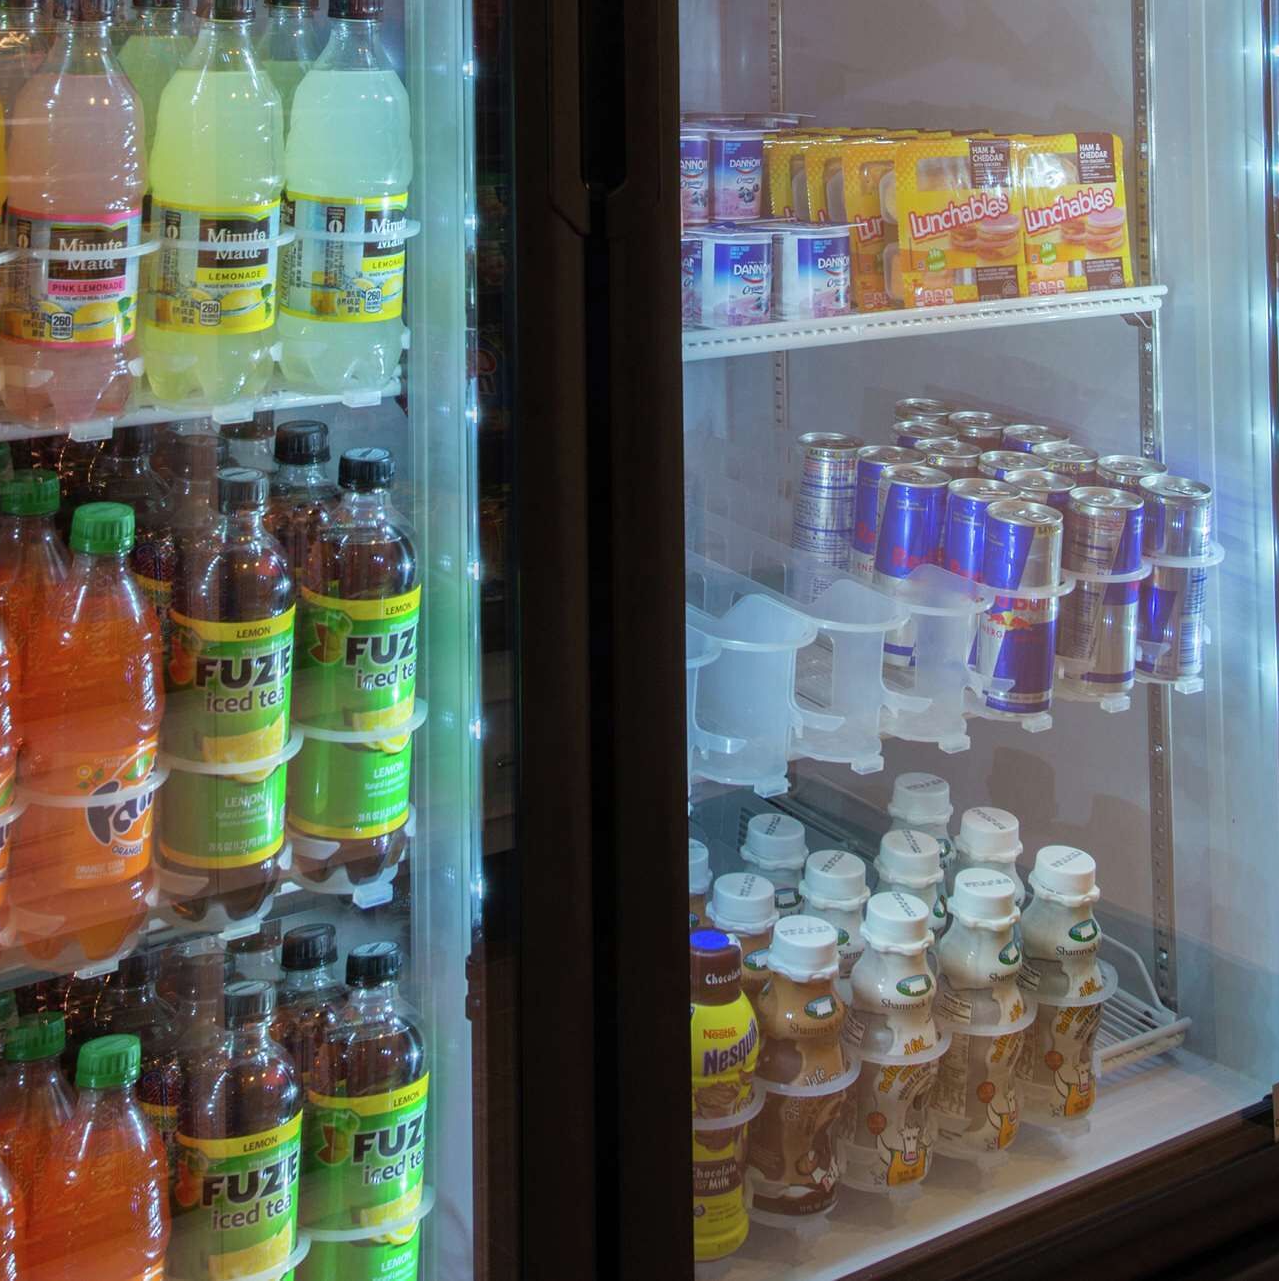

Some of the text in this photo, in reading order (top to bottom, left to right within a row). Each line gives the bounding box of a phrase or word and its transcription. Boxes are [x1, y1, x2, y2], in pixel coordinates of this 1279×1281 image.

[972, 146, 989, 155] HAM
[1079, 143, 1095, 152] HAM
[1079, 150, 1108, 160] CHEDDAR
[729, 158, 761, 169] DANNON
[972, 153, 1004, 163] CHEDDAR
[910, 193, 1009, 239] Lunchables
[1024, 187, 1114, 236] Lunchables
[370, 217, 407, 235] Minut
[208, 228, 266, 244] Minute
[59, 238, 123, 251] Minute
[67, 259, 115, 271] Maid
[208, 270, 261, 281] LEMONADE
[52, 282, 123, 293] PINK LEMONADE
[367, 290, 381, 301] 260
[202, 302, 219, 313] 260
[53, 315, 71, 327] 260
[385, 602, 412, 616] LEMON
[235, 626, 271, 639] LEMON
[345, 625, 417, 666] FUZ
[196, 644, 292, 689] FUZE
[356, 663, 398, 688] iced
[207, 686, 285, 713] iced tea
[373, 762, 405, 779] LEMON
[224, 792, 265, 808] LEMON
[703, 1026, 738, 1040] Nestlé
[392, 1090, 420, 1108] LEMON
[242, 1136, 279, 1153] LEMON
[351, 1114, 426, 1163] FUZ
[200, 1151, 298, 1207] FUZE
[362, 1159, 407, 1186] iced
[212, 1195, 293, 1232] iced tea
[380, 1250, 413, 1272] LEMON
